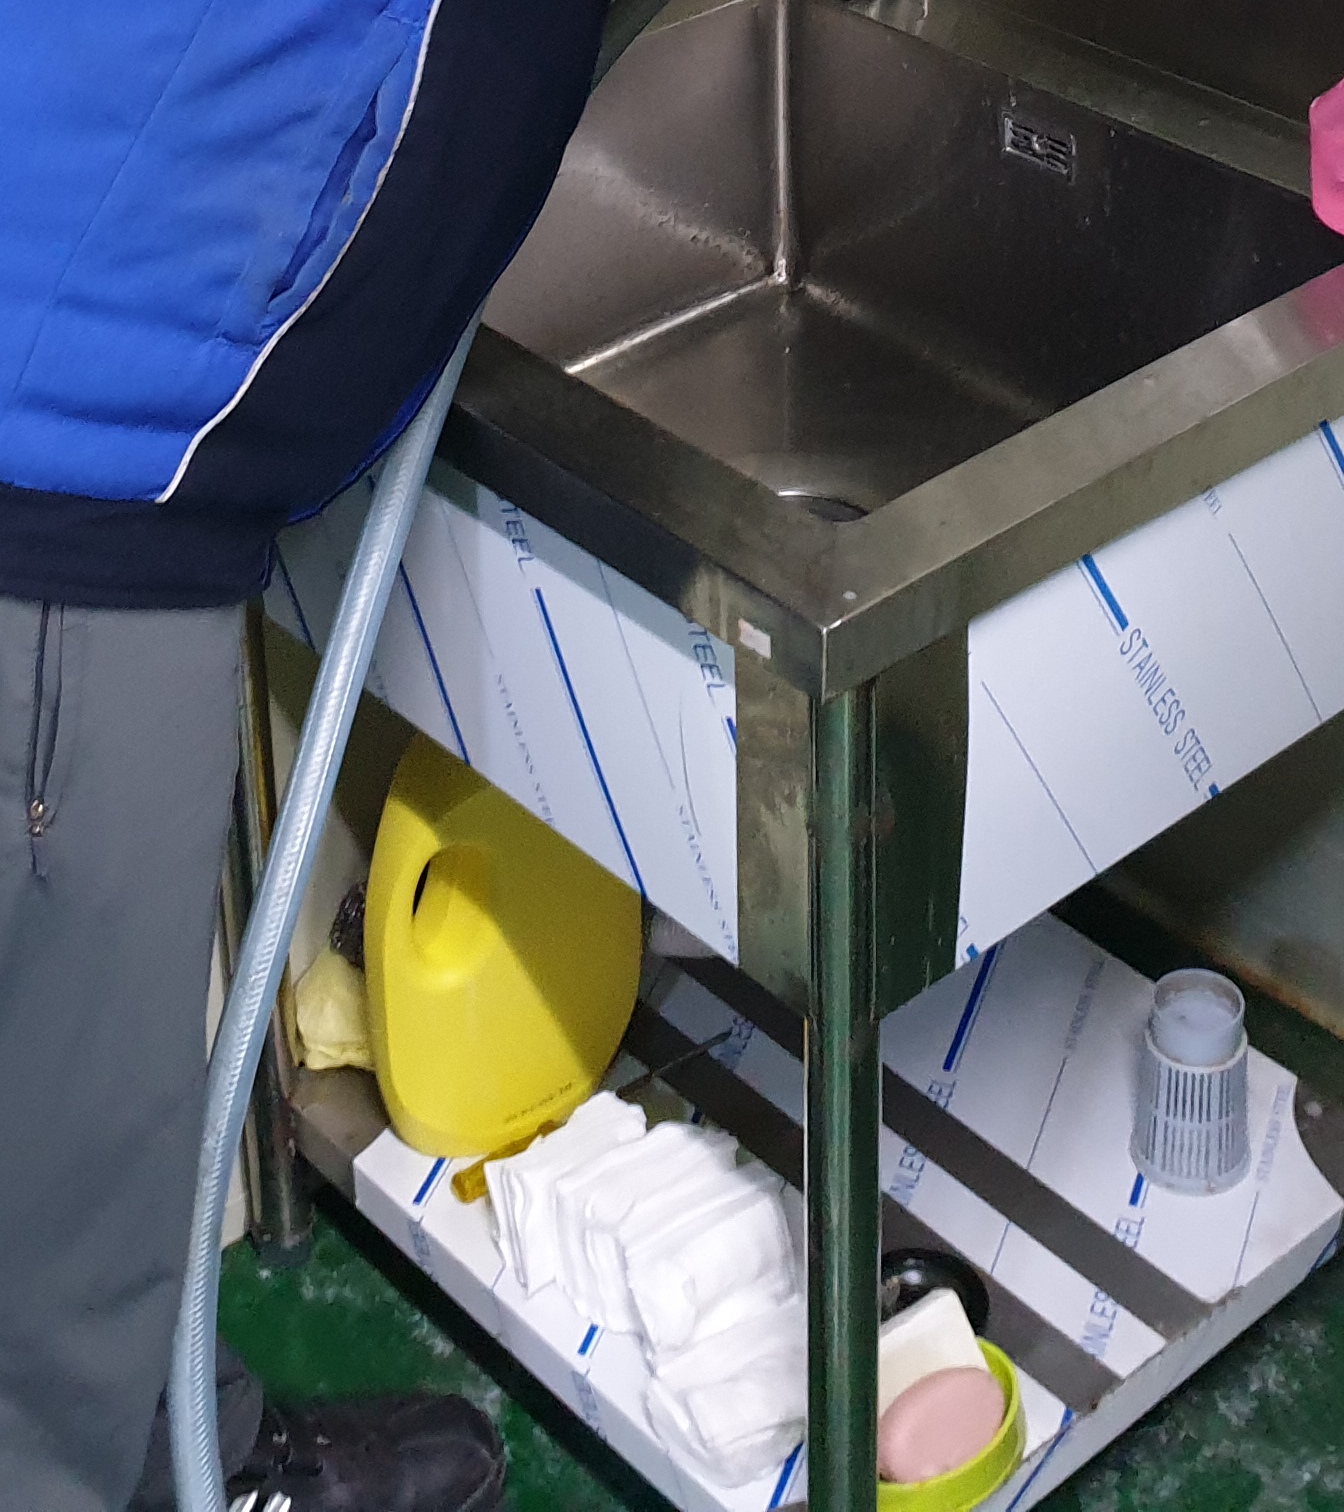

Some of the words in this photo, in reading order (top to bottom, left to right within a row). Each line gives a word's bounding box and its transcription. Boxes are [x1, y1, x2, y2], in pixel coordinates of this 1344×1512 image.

[499, 498, 536, 576] TEEL
[686, 619, 726, 705] TEEL
[1119, 627, 1186, 736] STAINLESS
[1173, 728, 1213, 791] STEEL
